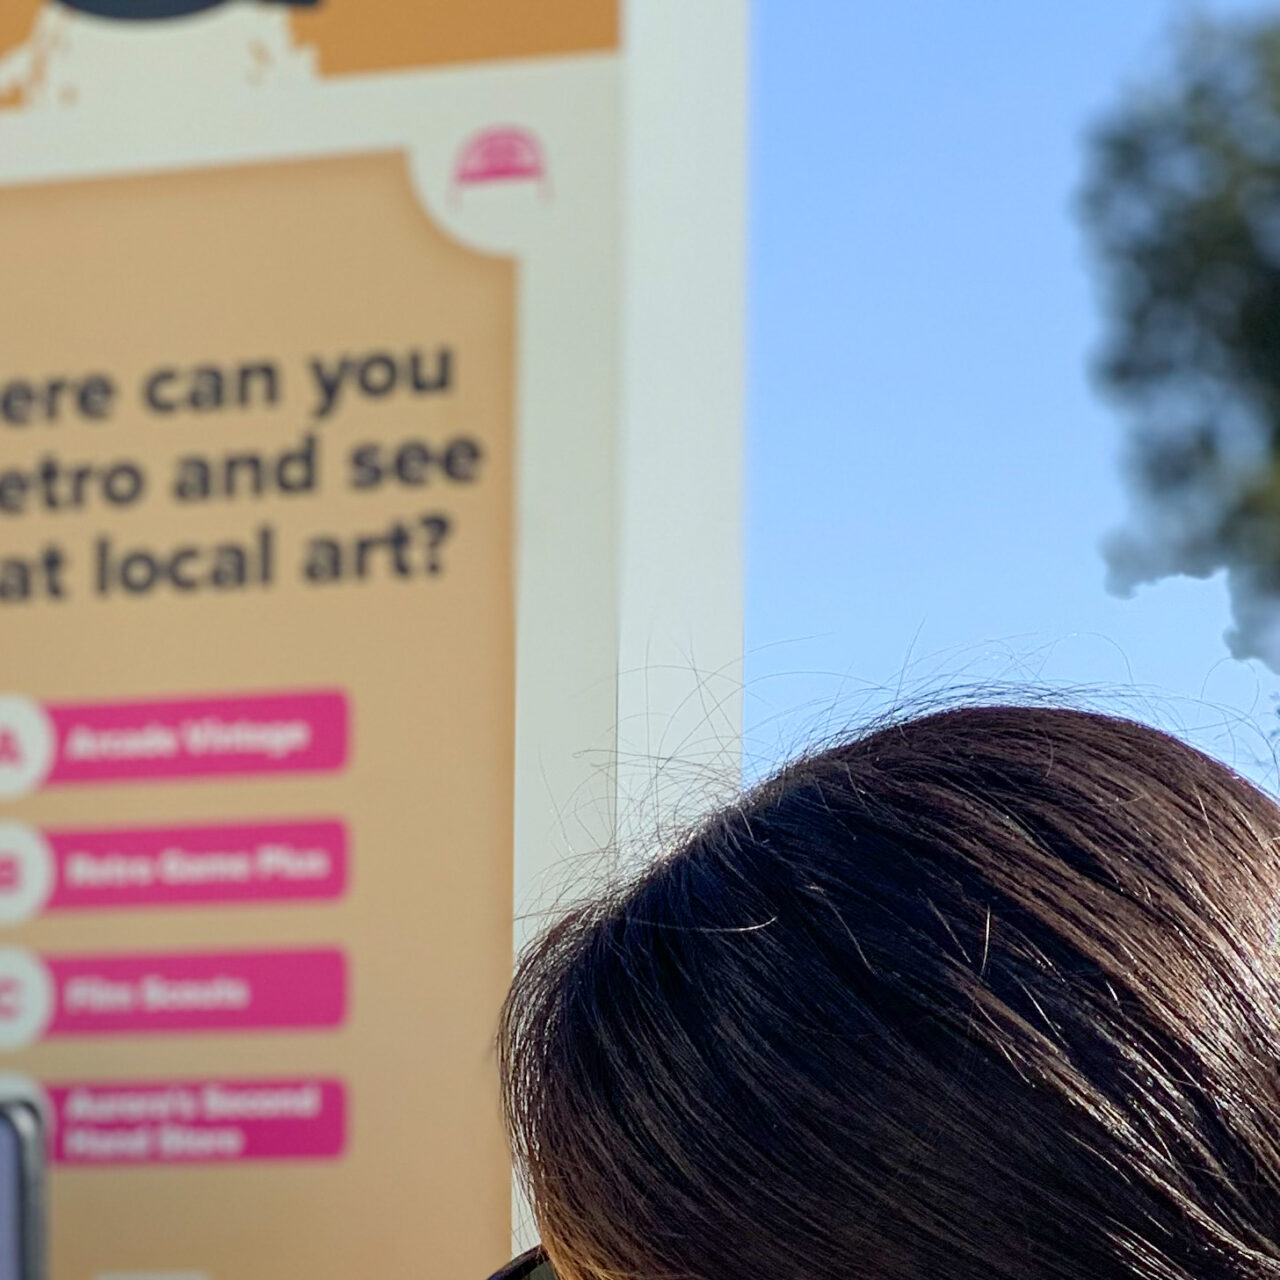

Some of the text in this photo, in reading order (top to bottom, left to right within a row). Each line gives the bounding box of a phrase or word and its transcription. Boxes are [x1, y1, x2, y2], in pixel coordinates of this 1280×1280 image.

[142, 361, 281, 416] can
[310, 347, 454, 420] you
[172, 432, 319, 502] and
[350, 435, 485, 491] see
[94, 525, 276, 598] local
[302, 512, 453, 584] art?
[65, 718, 310, 760] Arcade Vintage
[64, 852, 153, 887] Retro
[159, 848, 250, 884] Game
